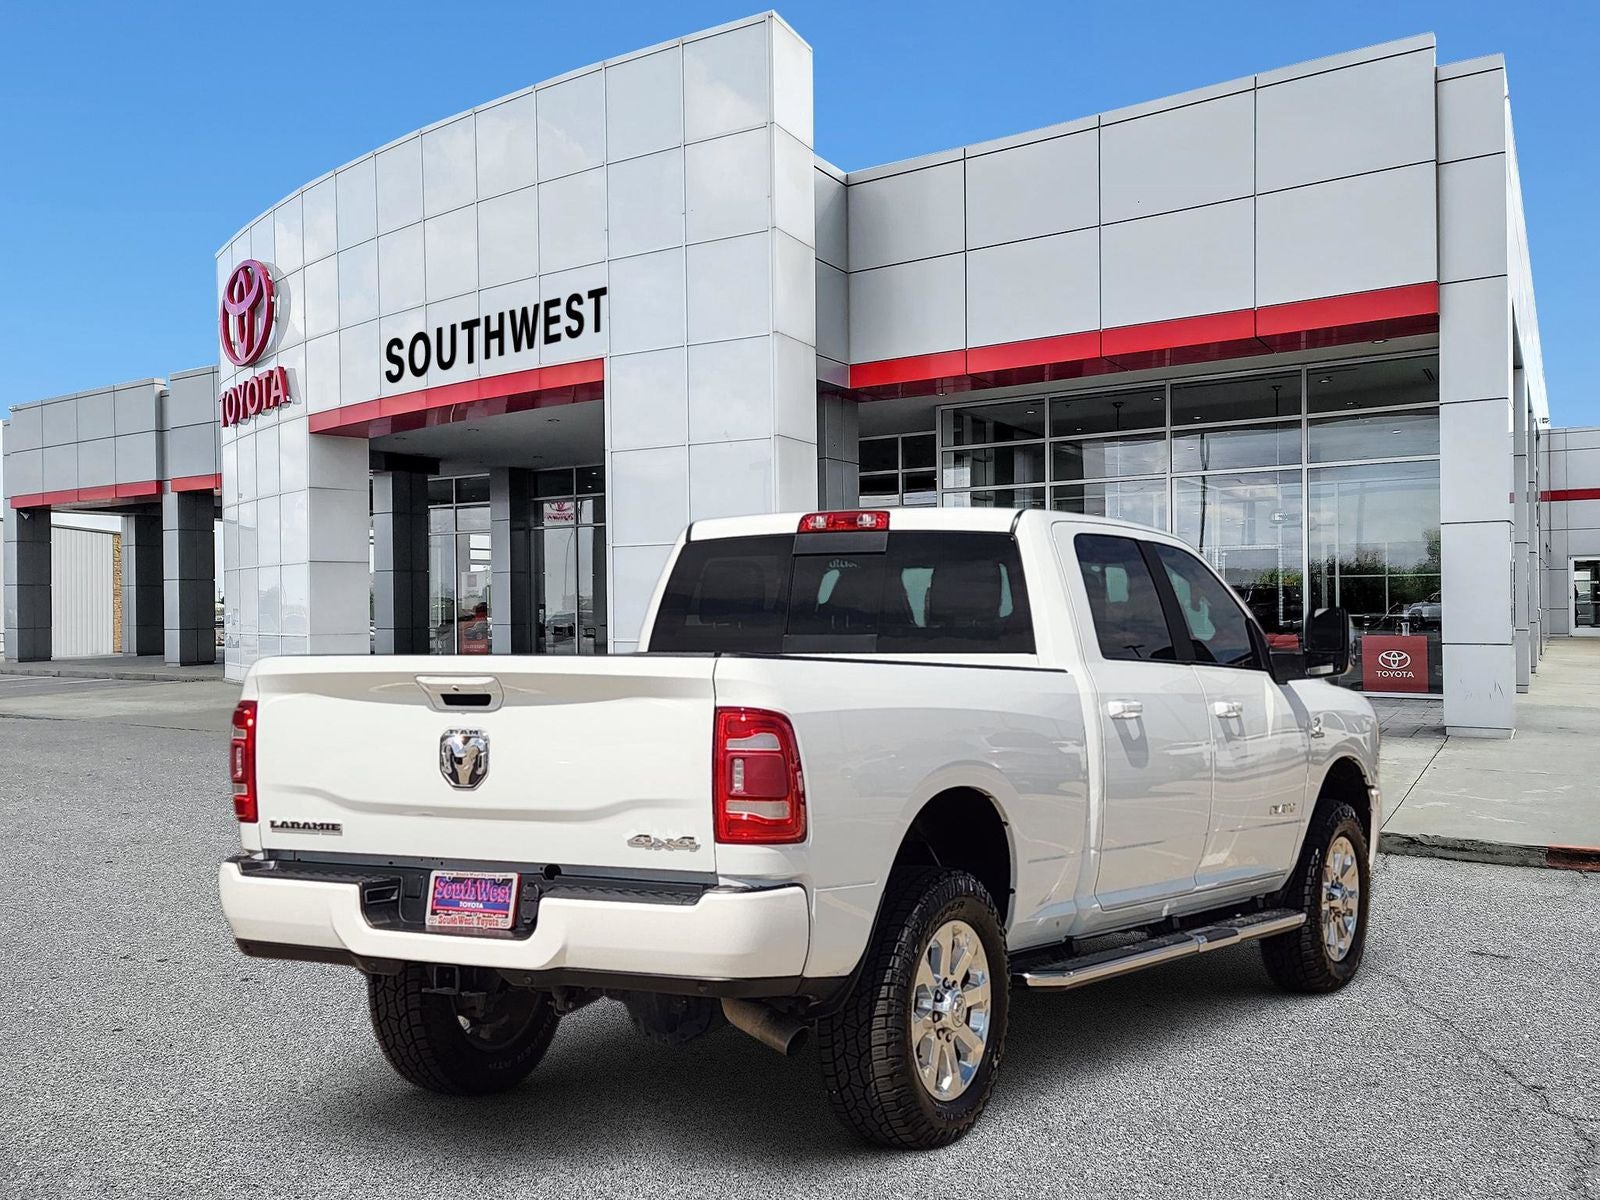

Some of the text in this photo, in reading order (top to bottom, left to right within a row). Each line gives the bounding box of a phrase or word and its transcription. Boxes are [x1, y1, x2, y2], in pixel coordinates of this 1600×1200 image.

[385, 286, 608, 384] SOUTHWEST
[218, 366, 291, 428] TOYOTA
[1376, 670, 1415, 678] TOYOTA
[269, 820, 342, 832] LARAMIE
[459, 901, 484, 909] TOYOTA
